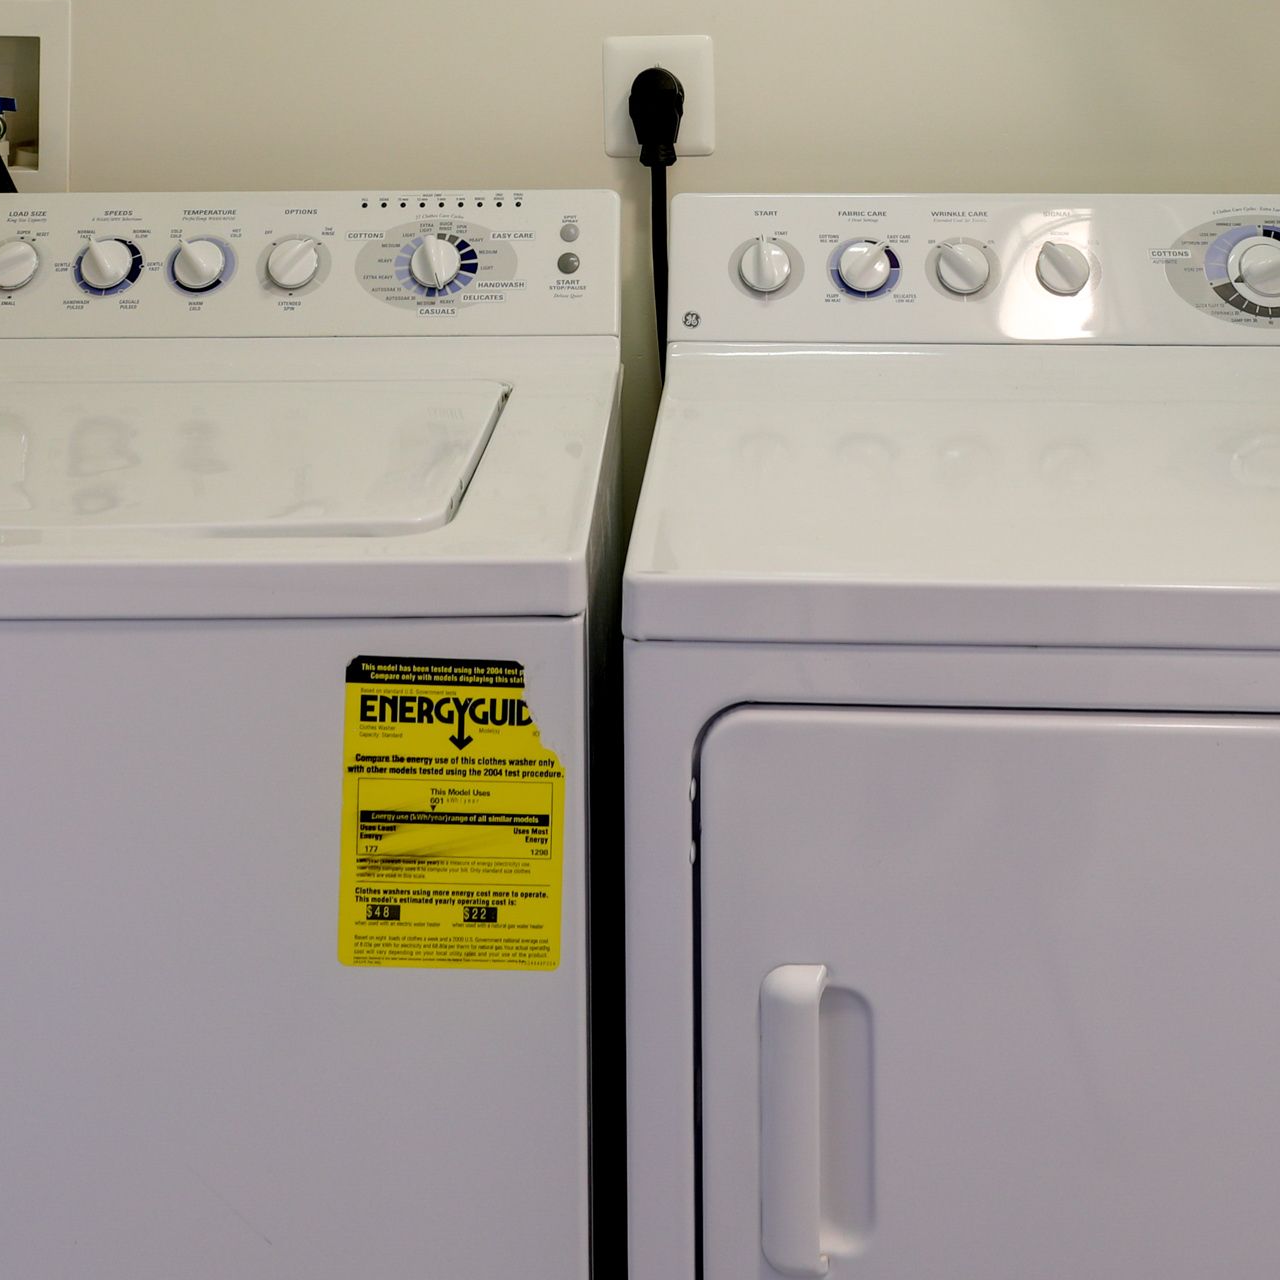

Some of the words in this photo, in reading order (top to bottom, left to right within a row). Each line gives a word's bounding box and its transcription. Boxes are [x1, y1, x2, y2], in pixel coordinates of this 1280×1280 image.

[361, 663, 376, 671] This
[377, 663, 398, 671] model
[399, 664, 411, 672] has
[412, 664, 429, 673] been
[430, 665, 452, 673] tested
[453, 666, 472, 674] using
[486, 667, 503, 675] 2004
[370, 671, 400, 681] Compare
[401, 673, 416, 682] only
[417, 673, 432, 681] with
[433, 674, 458, 682] models
[459, 675, 494, 684] displaying
[495, 675, 508, 683] this
[355, 753, 390, 763] Compare
[391, 754, 405, 763] the
[406, 756, 433, 765] energy
[450, 756, 459, 764] of
[461, 756, 476, 765] this
[477, 757, 507, 765] clothes
[508, 758, 536, 766] washer
[538, 758, 555, 768] only
[347, 765, 365, 773] with
[366, 765, 387, 774] other
[389, 766, 417, 775] models
[419, 767, 444, 775] tested
[445, 768, 467, 777] using
[469, 768, 482, 776] the
[483, 768, 502, 777] 2004
[504, 769, 520, 777] test
[521, 770, 564, 779] procedure.
[447, 788, 470, 796] Model
[473, 789, 491, 797] Uses
[371, 812, 395, 821] Energy
[448, 815, 468, 823] range
[477, 815, 487, 823] all
[488, 815, 513, 823] similar
[513, 816, 539, 824] models
[360, 832, 383, 841] Energy
[525, 836, 548, 844] Energy
[354, 887, 381, 895] Clothes
[412, 889, 431, 897] using
[520, 891, 549, 899] operate.
[355, 895, 369, 903] This
[435, 897, 456, 905] yearly
[457, 898, 490, 907] operating
